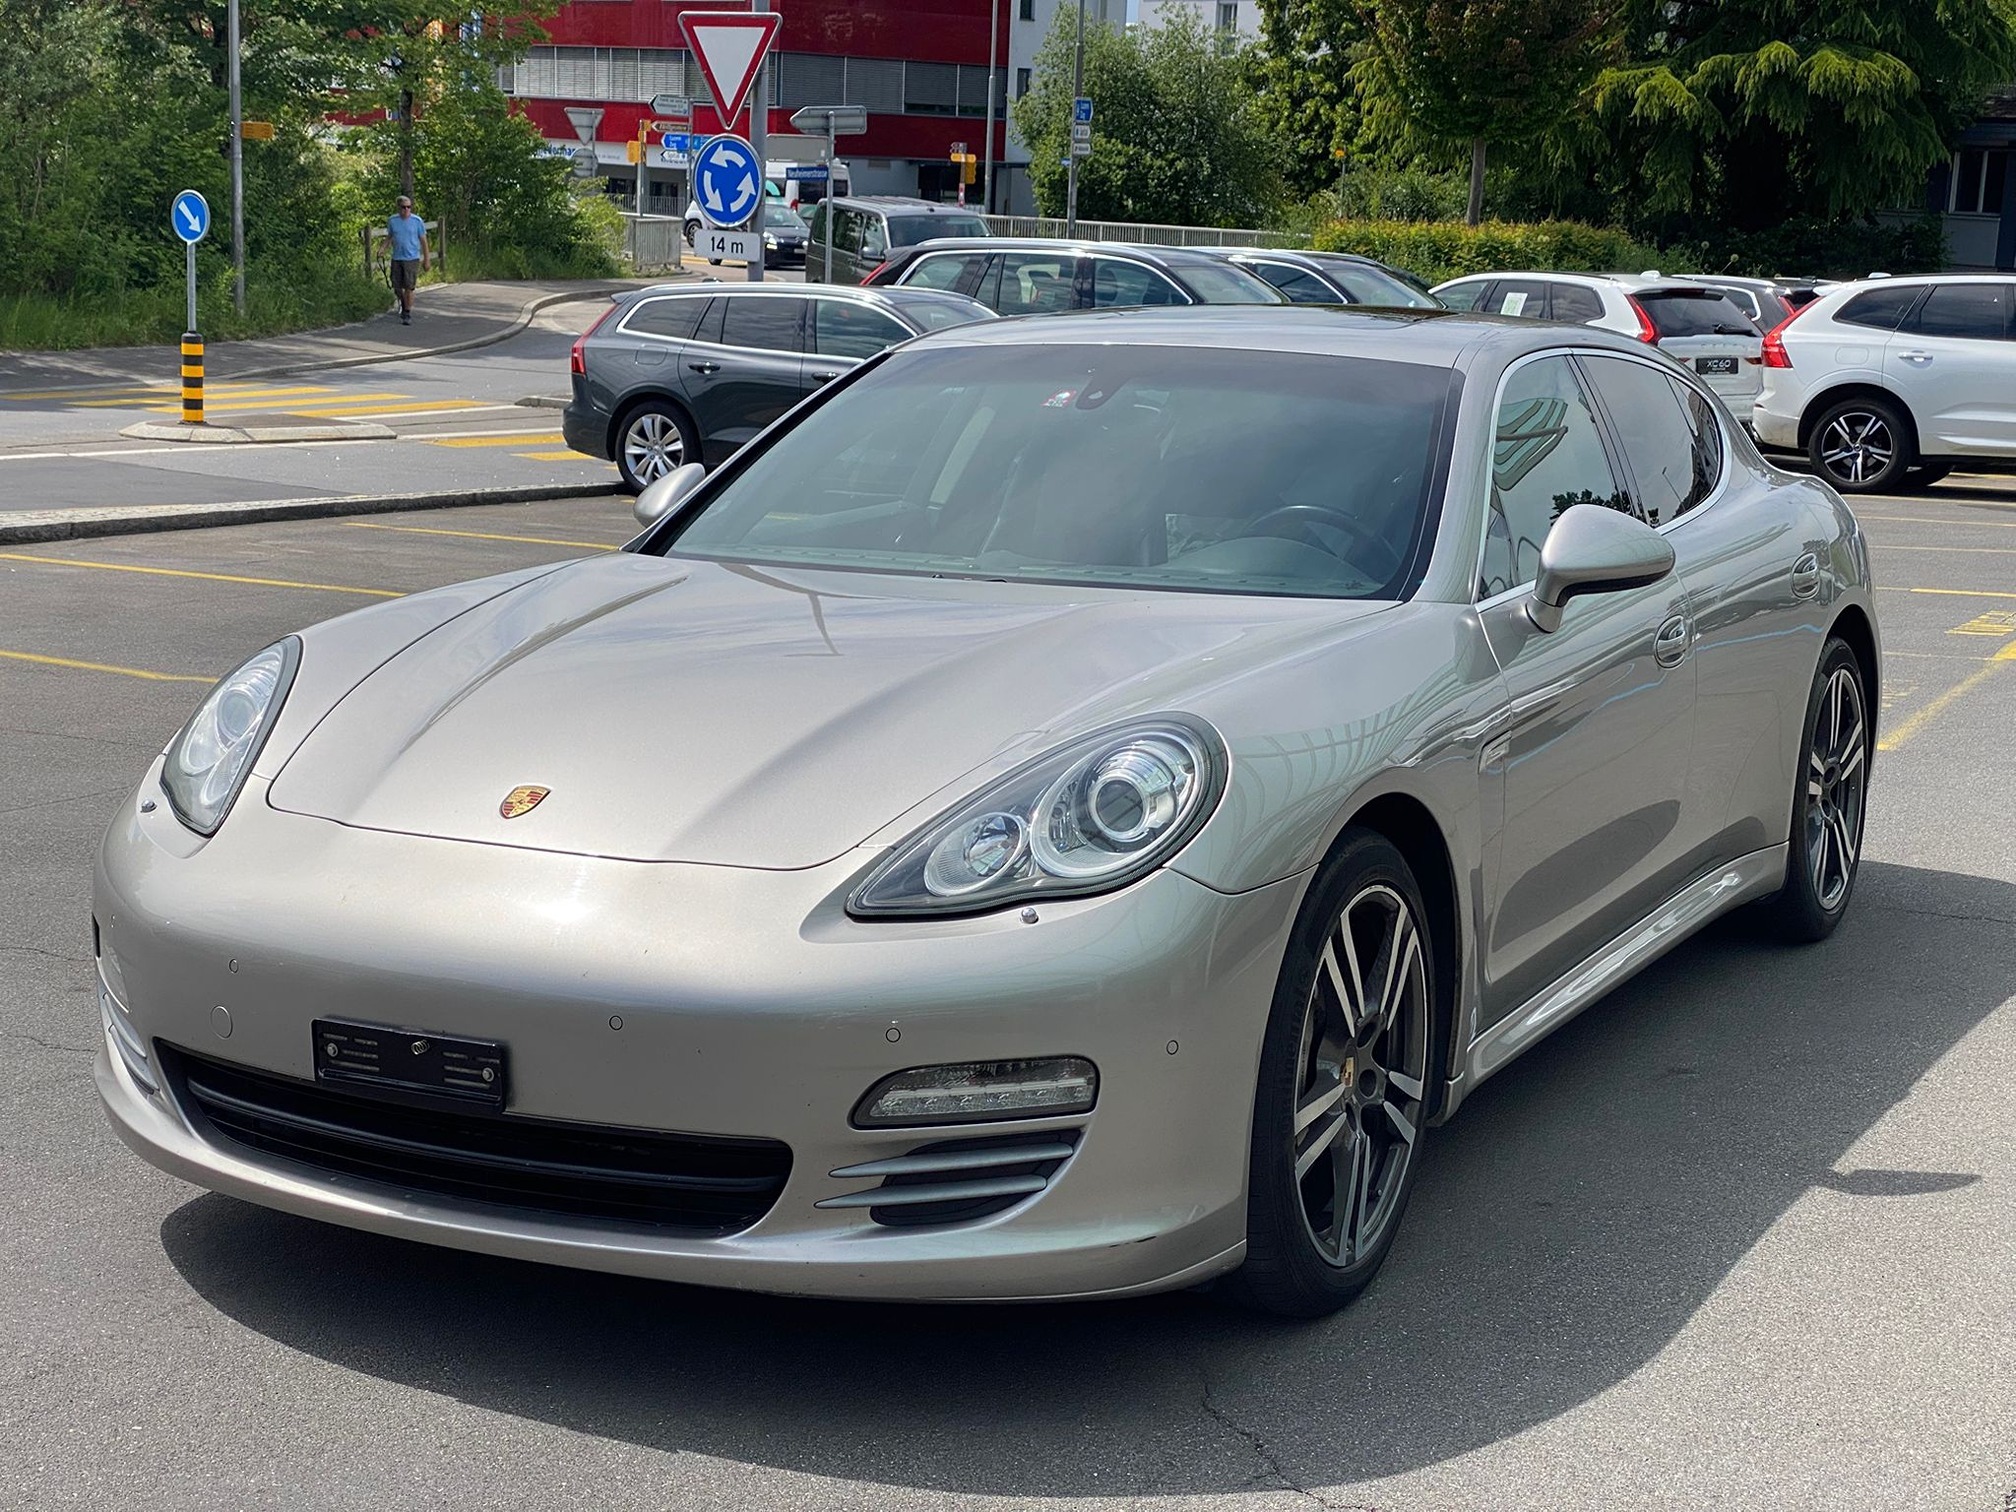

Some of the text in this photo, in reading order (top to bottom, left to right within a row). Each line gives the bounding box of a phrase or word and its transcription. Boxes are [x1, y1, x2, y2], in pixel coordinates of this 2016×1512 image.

[711, 236, 744, 254] 14 m
[1706, 359, 1731, 368] XC60
